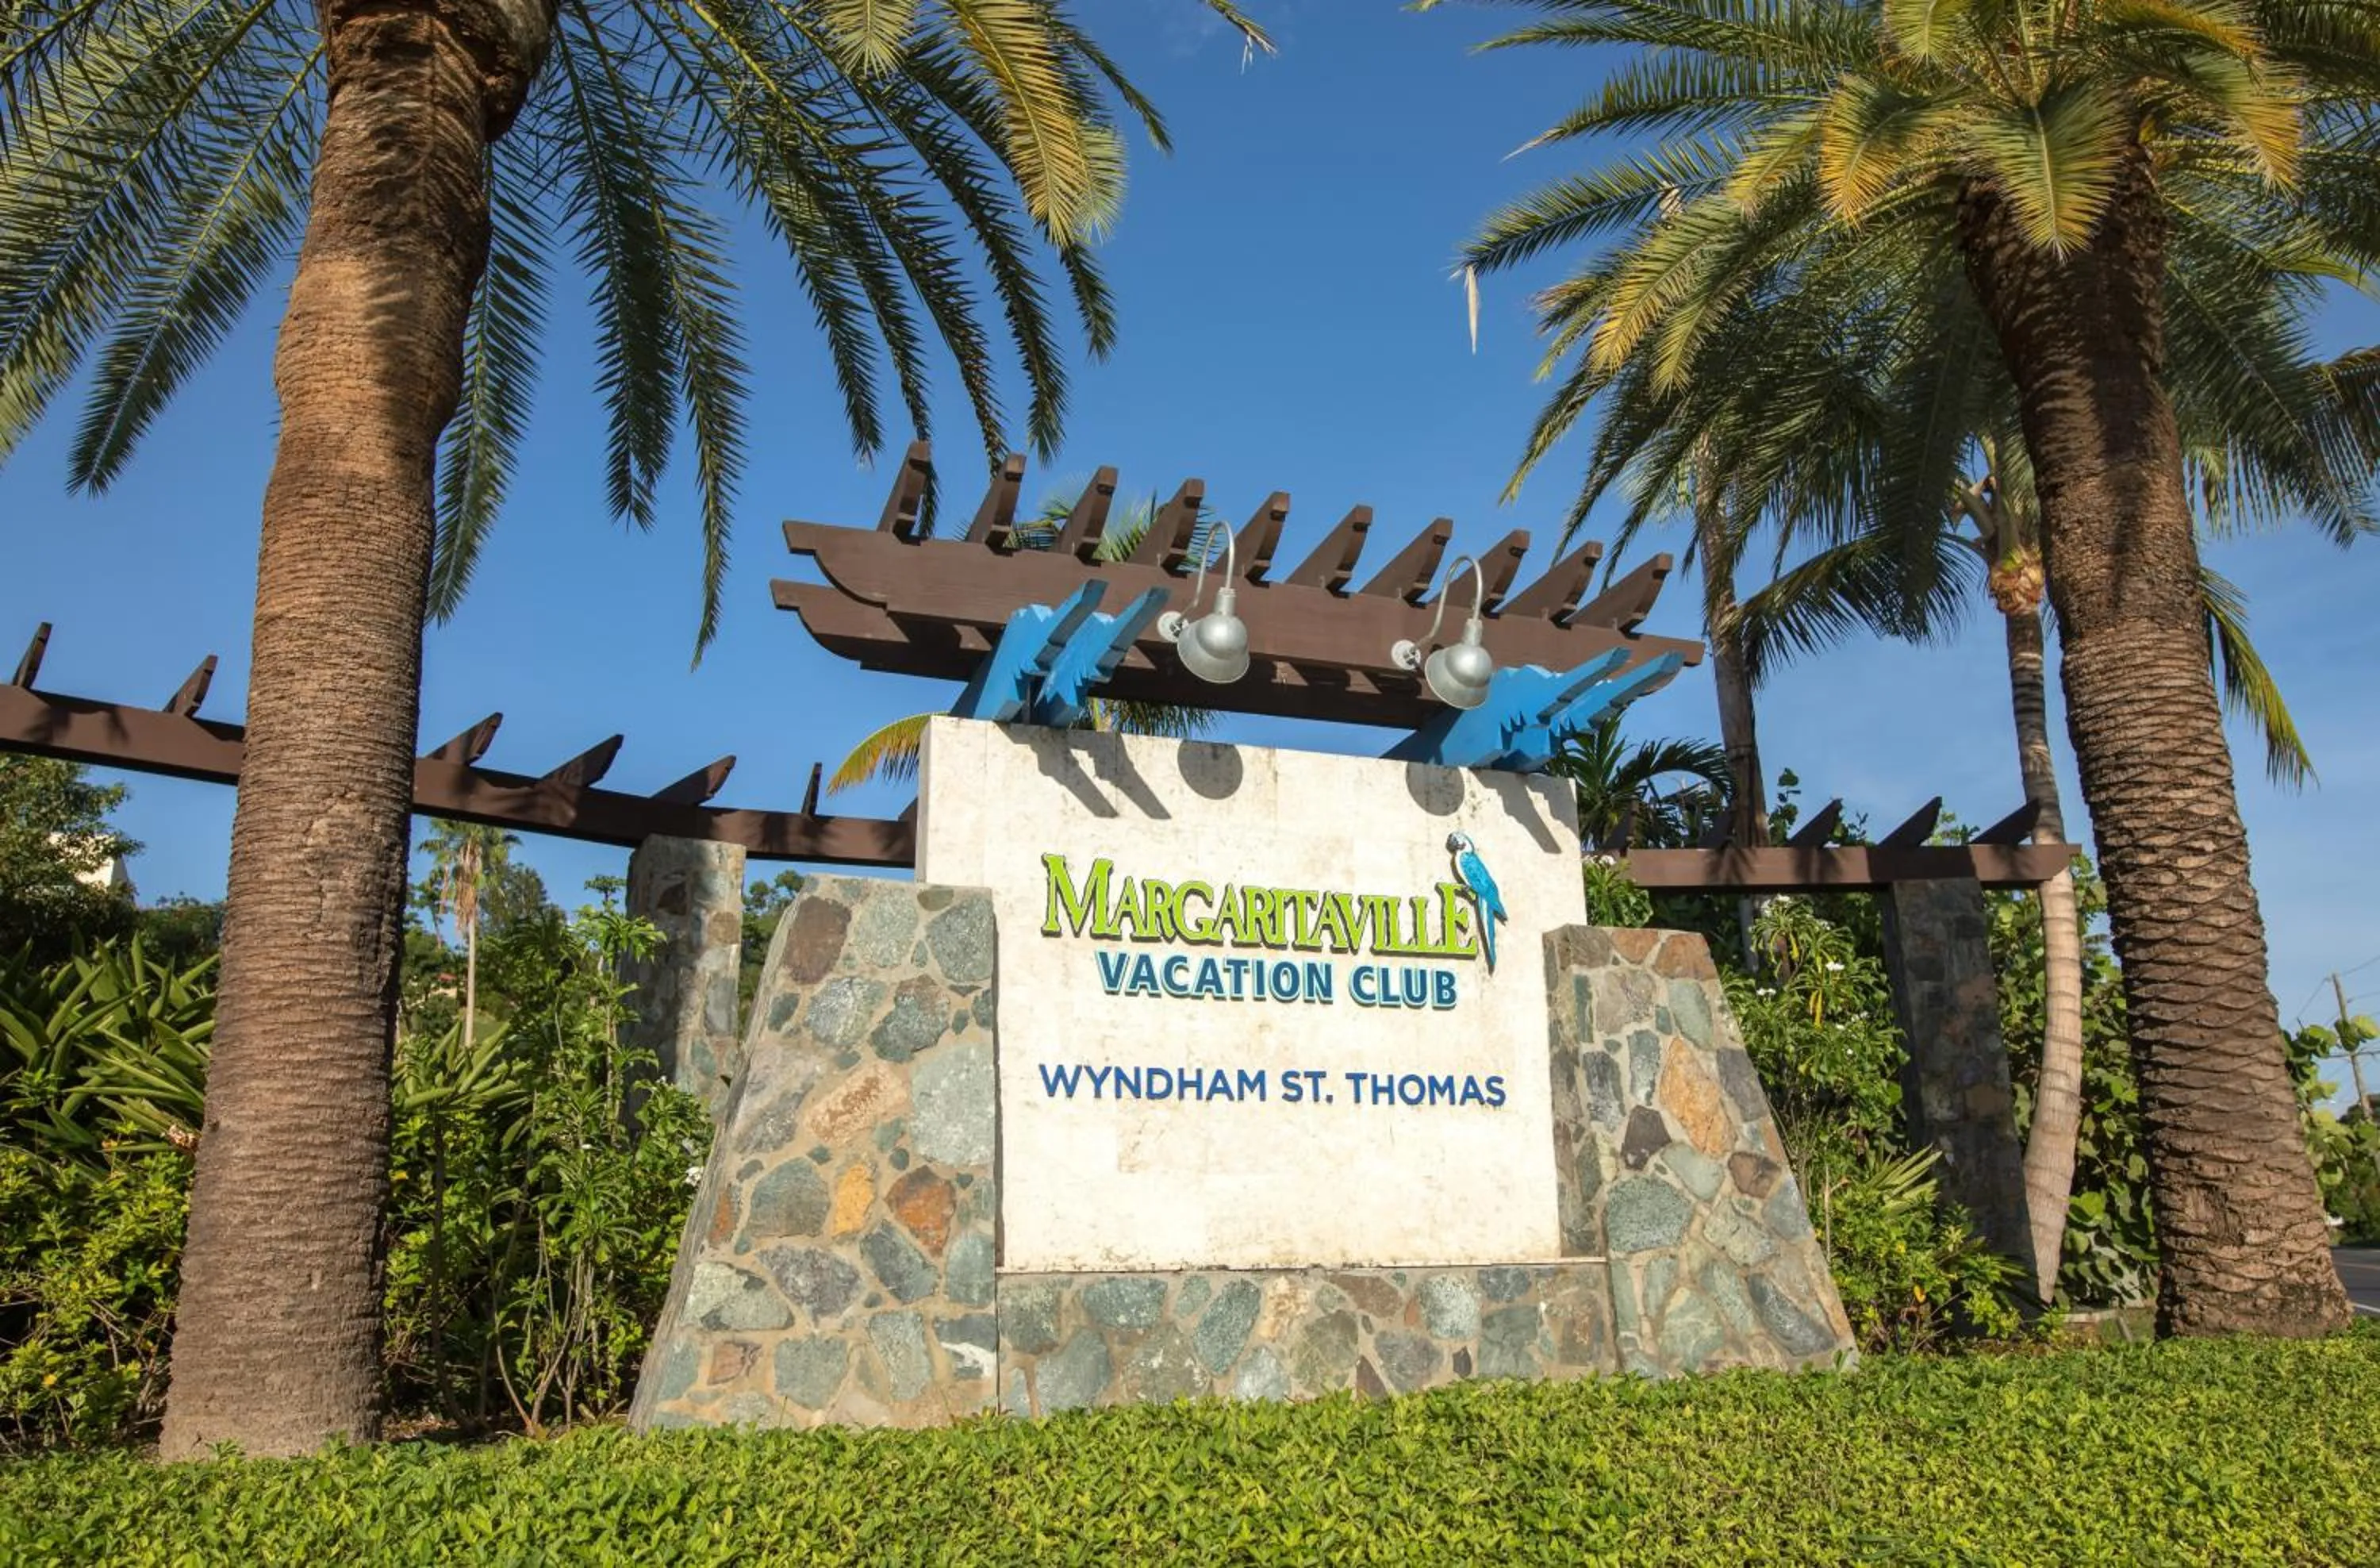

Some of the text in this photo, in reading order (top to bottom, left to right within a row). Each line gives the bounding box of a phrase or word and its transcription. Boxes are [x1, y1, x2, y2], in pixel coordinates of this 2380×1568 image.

[1041, 853, 1478, 958] MARGARITAVILLE
[1096, 951, 1458, 1009] VACATION CLUB
[1038, 1063, 1507, 1106] WYNDHAM ST. THOMAS
